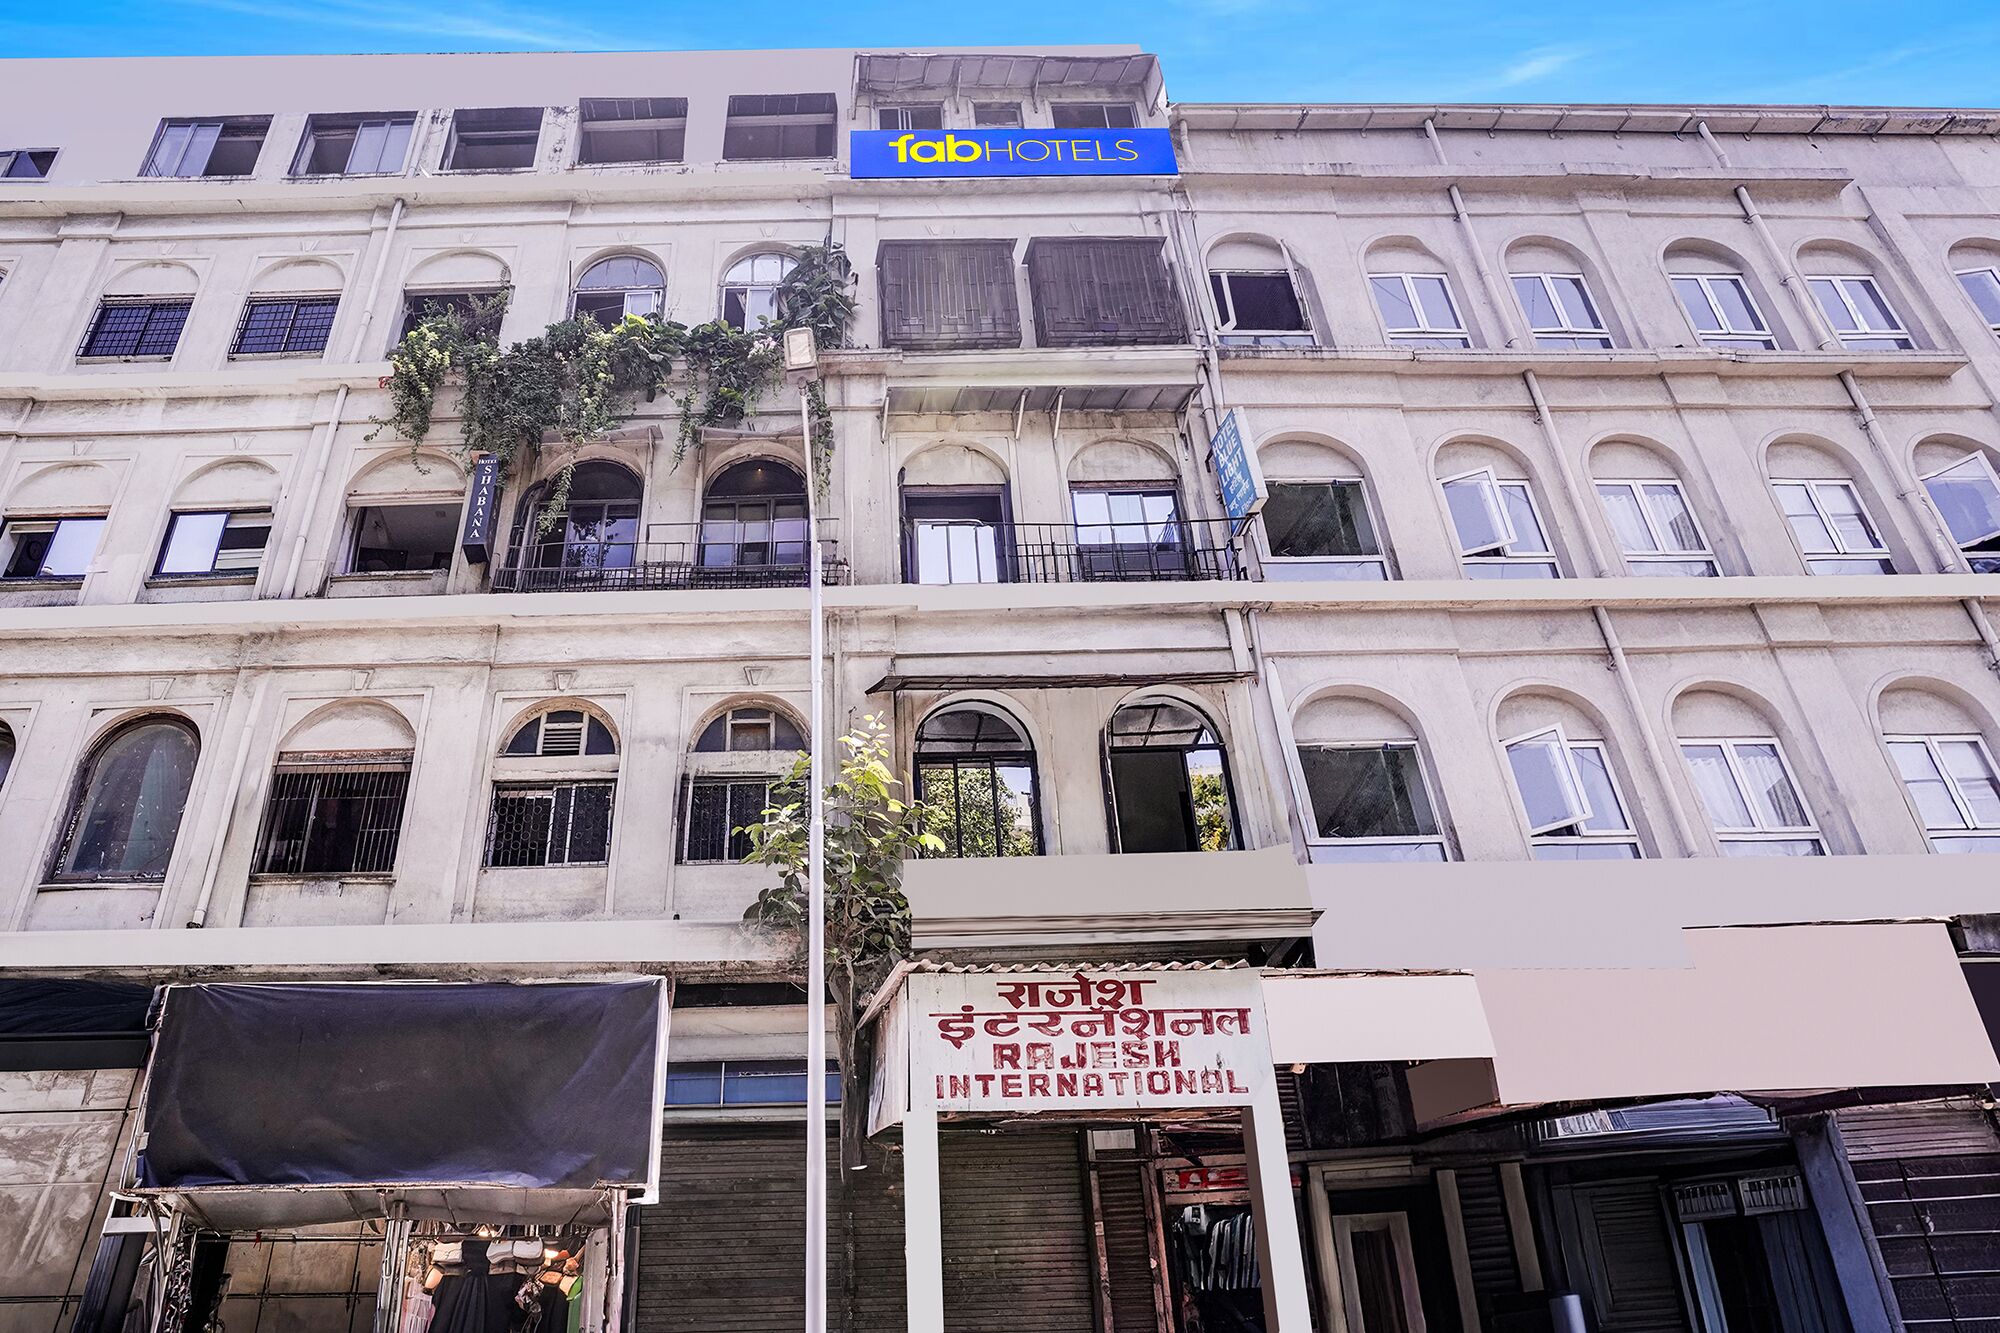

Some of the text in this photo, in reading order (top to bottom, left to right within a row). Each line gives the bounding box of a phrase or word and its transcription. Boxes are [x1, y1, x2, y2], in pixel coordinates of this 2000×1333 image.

[889, 133, 1139, 163] fabHOTELS
[1212, 417, 1236, 457] HOTEL
[1218, 432, 1239, 468] BLUE
[1221, 447, 1243, 488] LIGHT
[469, 465, 492, 538] SHABANA
[996, 971, 1157, 1010] राजेश
[993, 1040, 1182, 1070] RAJESH
[936, 1069, 1249, 1099] INTERNATIONAL
